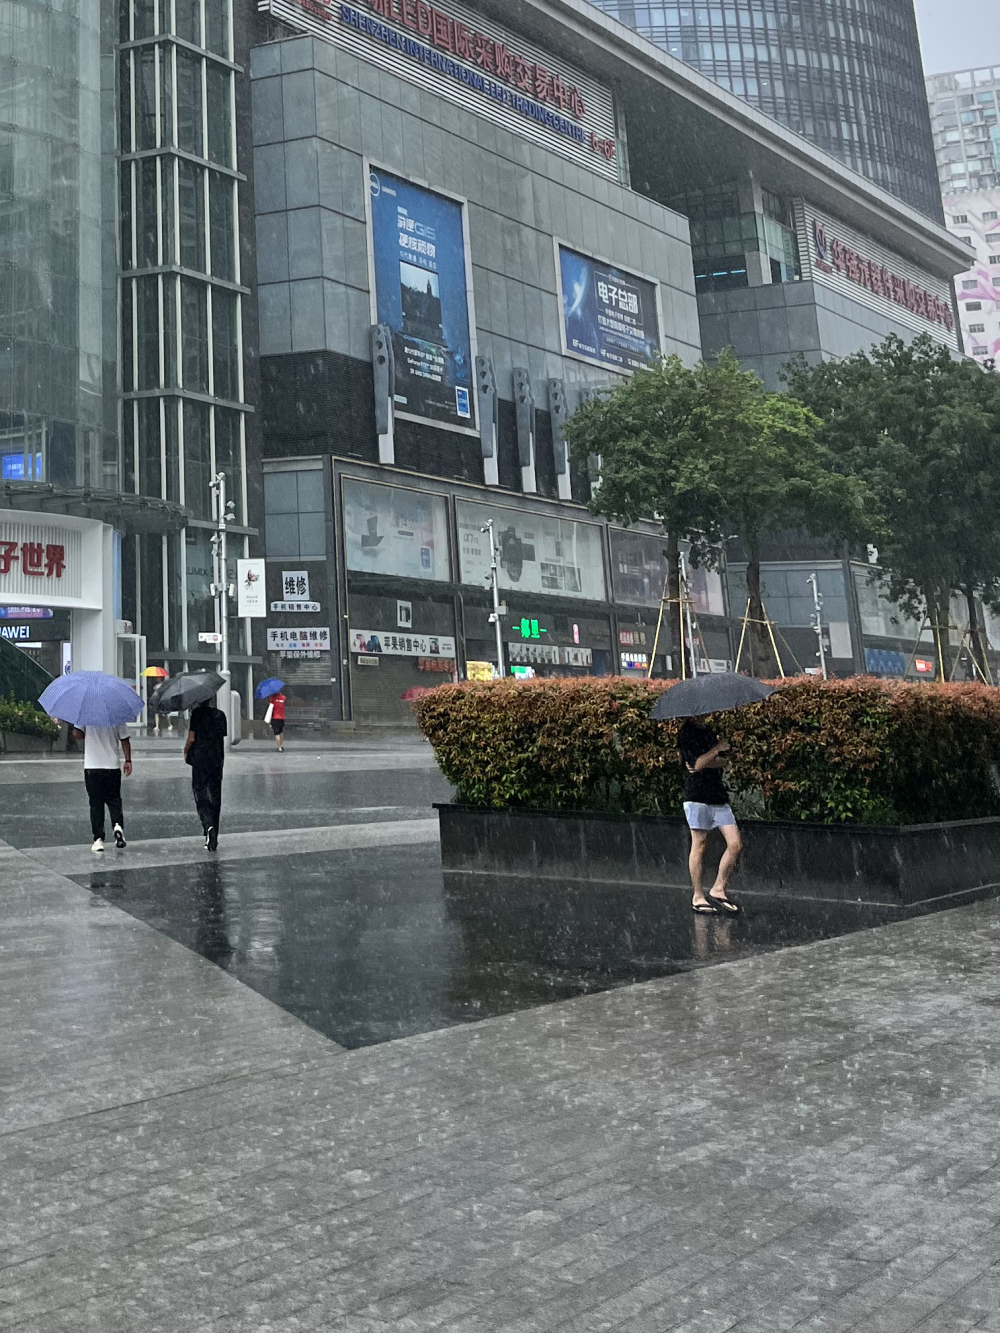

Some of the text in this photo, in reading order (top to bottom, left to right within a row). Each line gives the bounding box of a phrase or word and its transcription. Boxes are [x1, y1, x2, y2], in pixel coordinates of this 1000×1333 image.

[340, 3, 406, 51] SHENZHEN
[512, 94, 553, 126] TRADING
[597, 281, 639, 314] 电子总部
[284, 576, 307, 595] 维修
[273, 603, 318, 611] 手机销售中心
[270, 630, 328, 641] 手机电脑维修
[384, 636, 426, 652] 苹果销售中心
